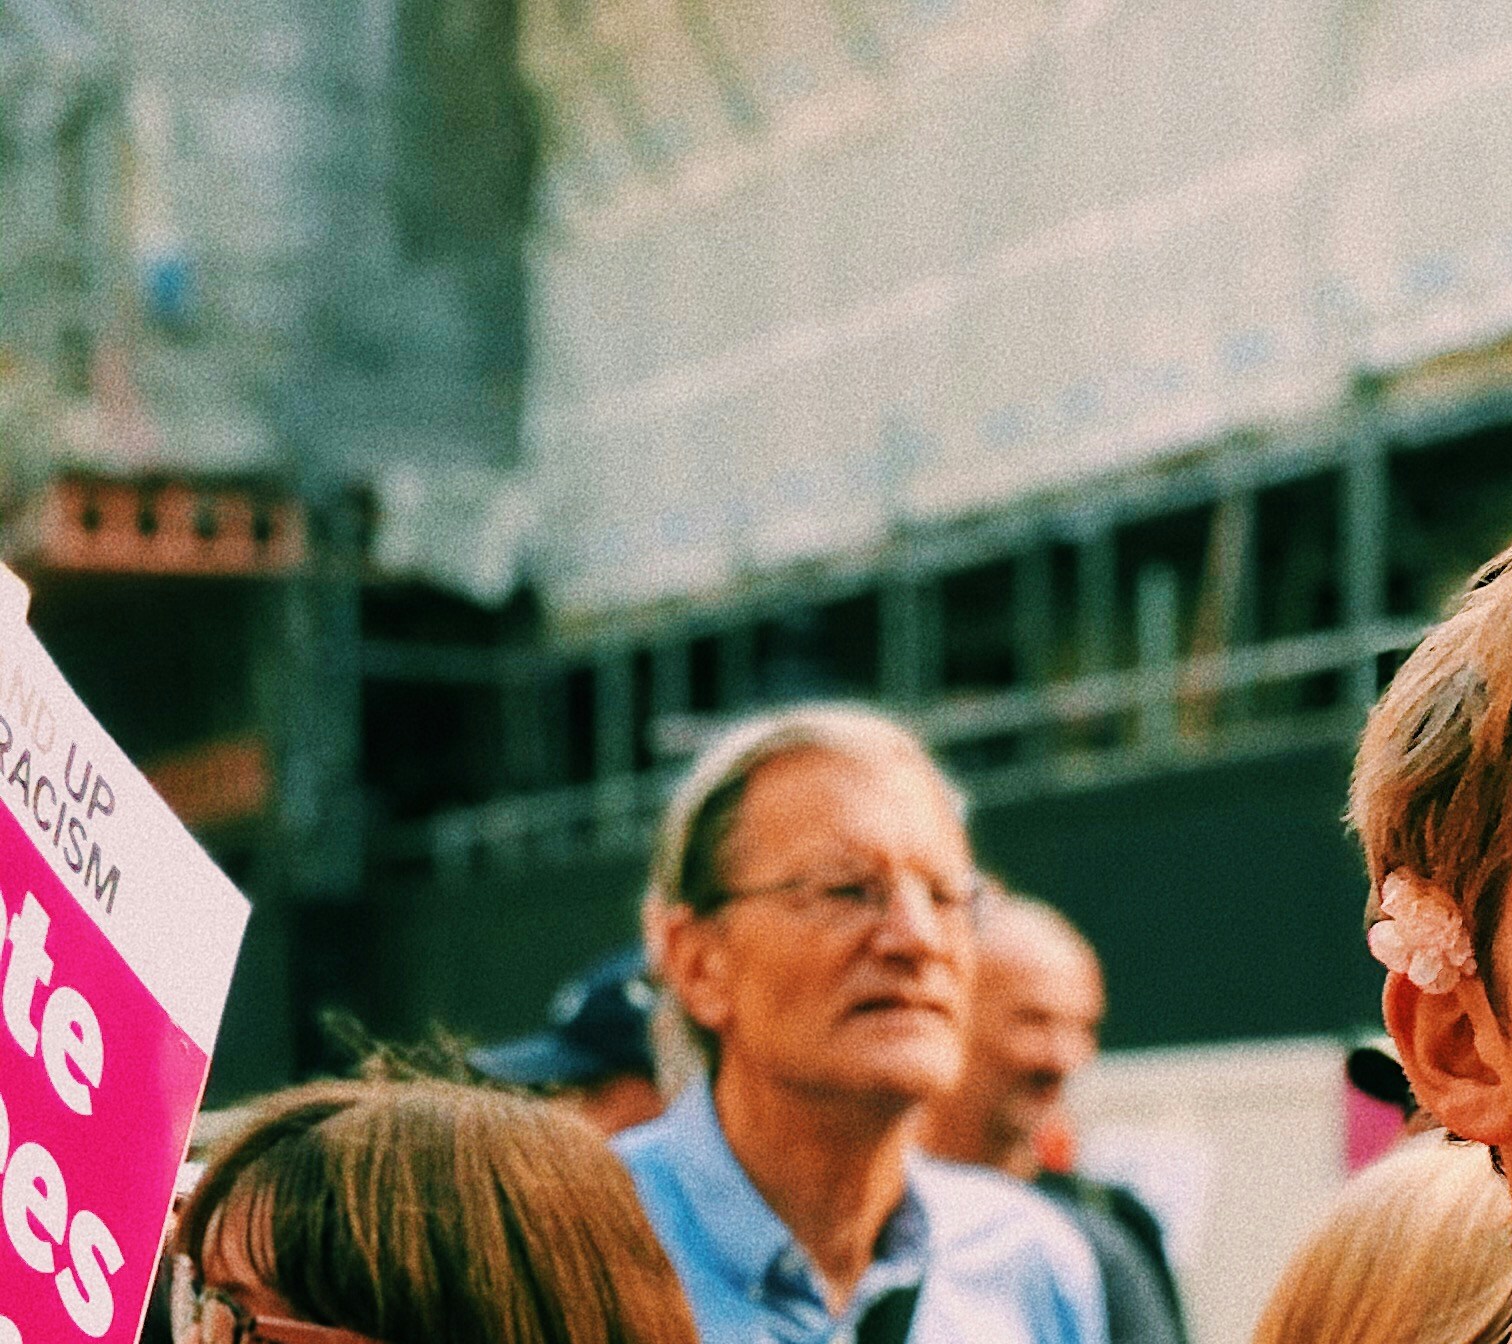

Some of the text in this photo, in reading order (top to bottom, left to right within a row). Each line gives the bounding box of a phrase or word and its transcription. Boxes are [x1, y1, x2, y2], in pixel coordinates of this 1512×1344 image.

[63, 740, 116, 820] UP
[0, 888, 105, 1117] te
[0, 1092, 126, 1338] es
